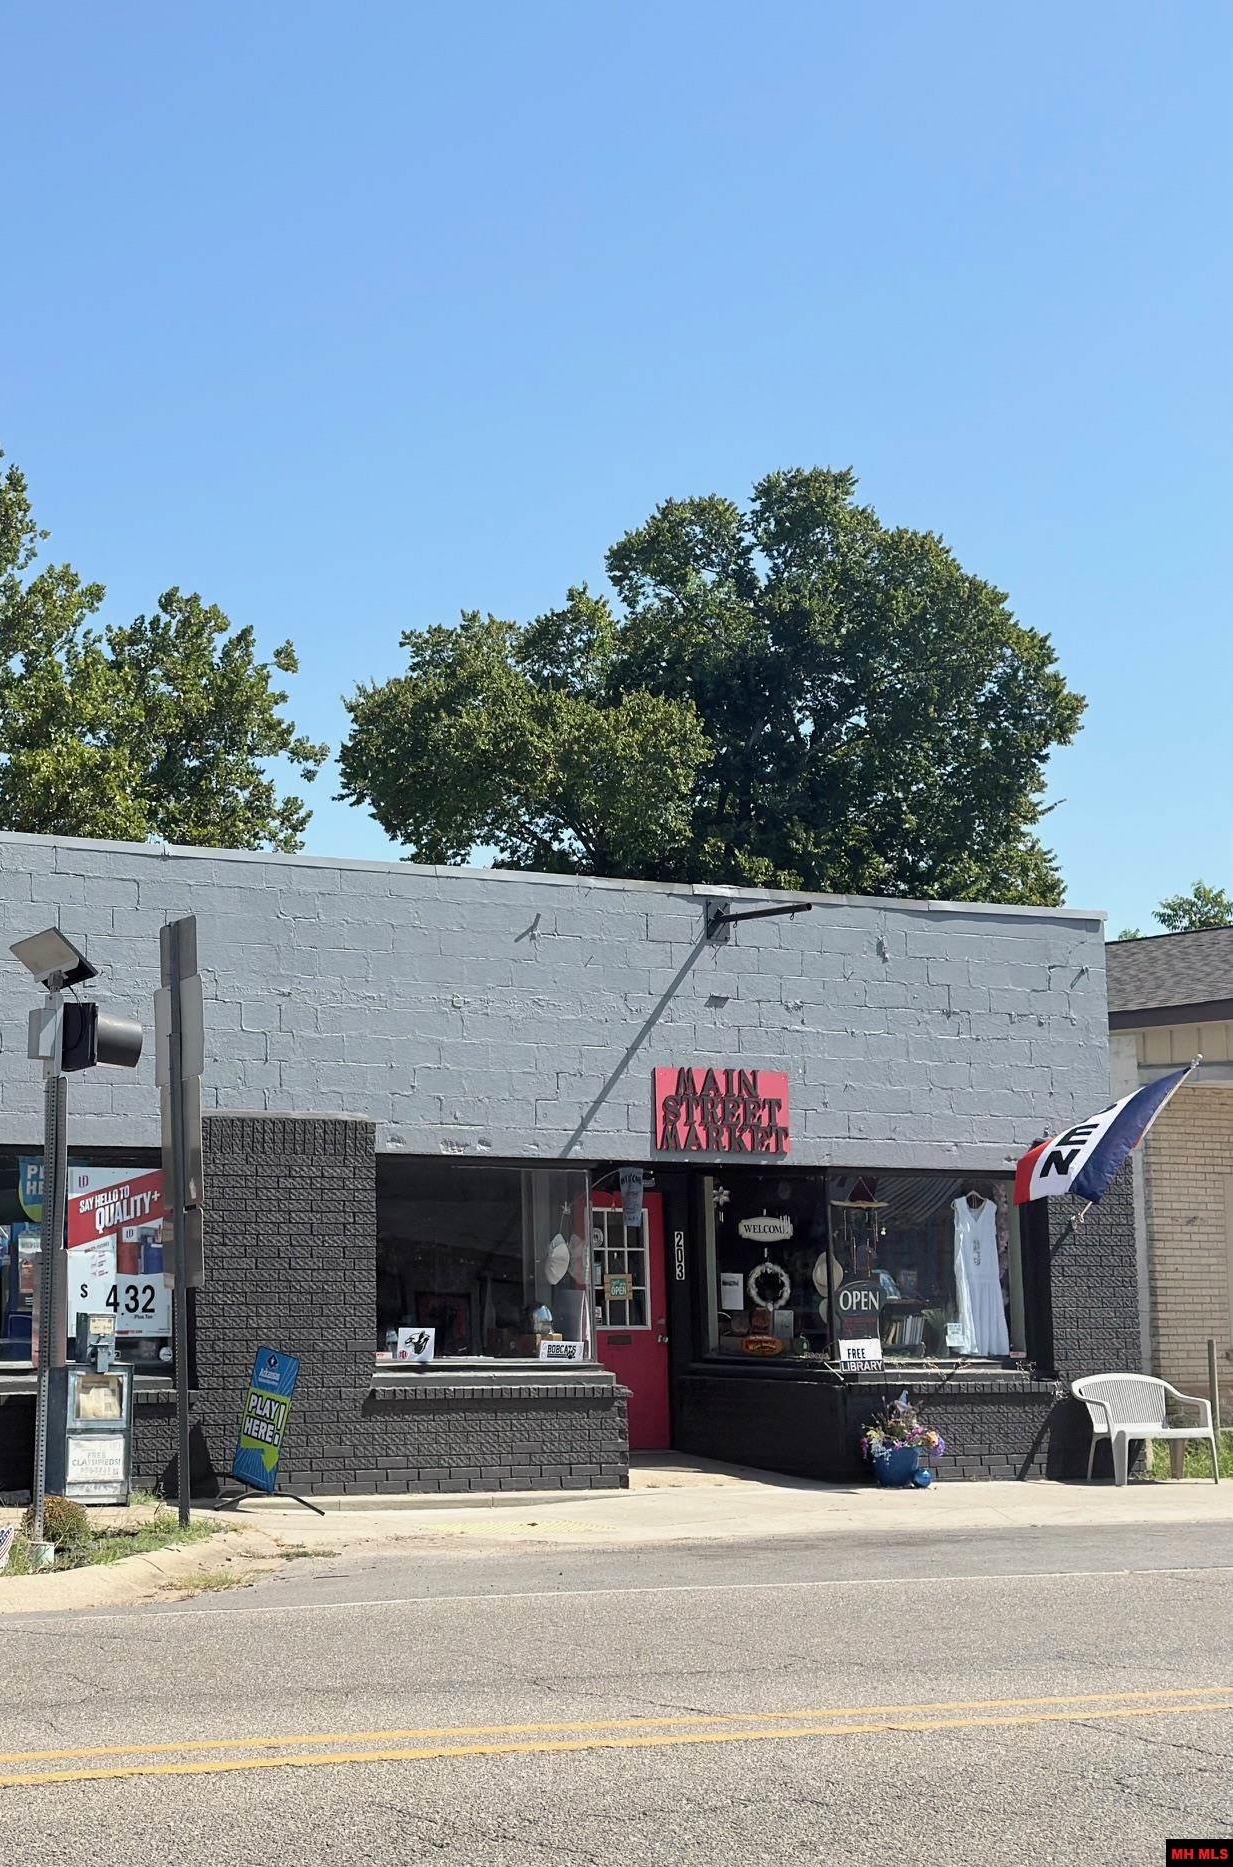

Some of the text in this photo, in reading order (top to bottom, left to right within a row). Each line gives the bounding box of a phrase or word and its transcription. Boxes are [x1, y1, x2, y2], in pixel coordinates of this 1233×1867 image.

[675, 1067, 760, 1098] MAIN
[662, 1095, 782, 1126] STREET
[659, 1124, 789, 1153] MARKET
[79, 1185, 129, 1213] SAY HELLO TO
[676, 1232, 684, 1279] 203
[611, 1286, 626, 1295] OPEN
[839, 1290, 879, 1310] OPEN
[547, 1344, 576, 1355] BOBCATS
[847, 1348, 866, 1359] FREE
[841, 1361, 883, 1372] LIBRARY
[247, 1394, 280, 1420] PLAY
